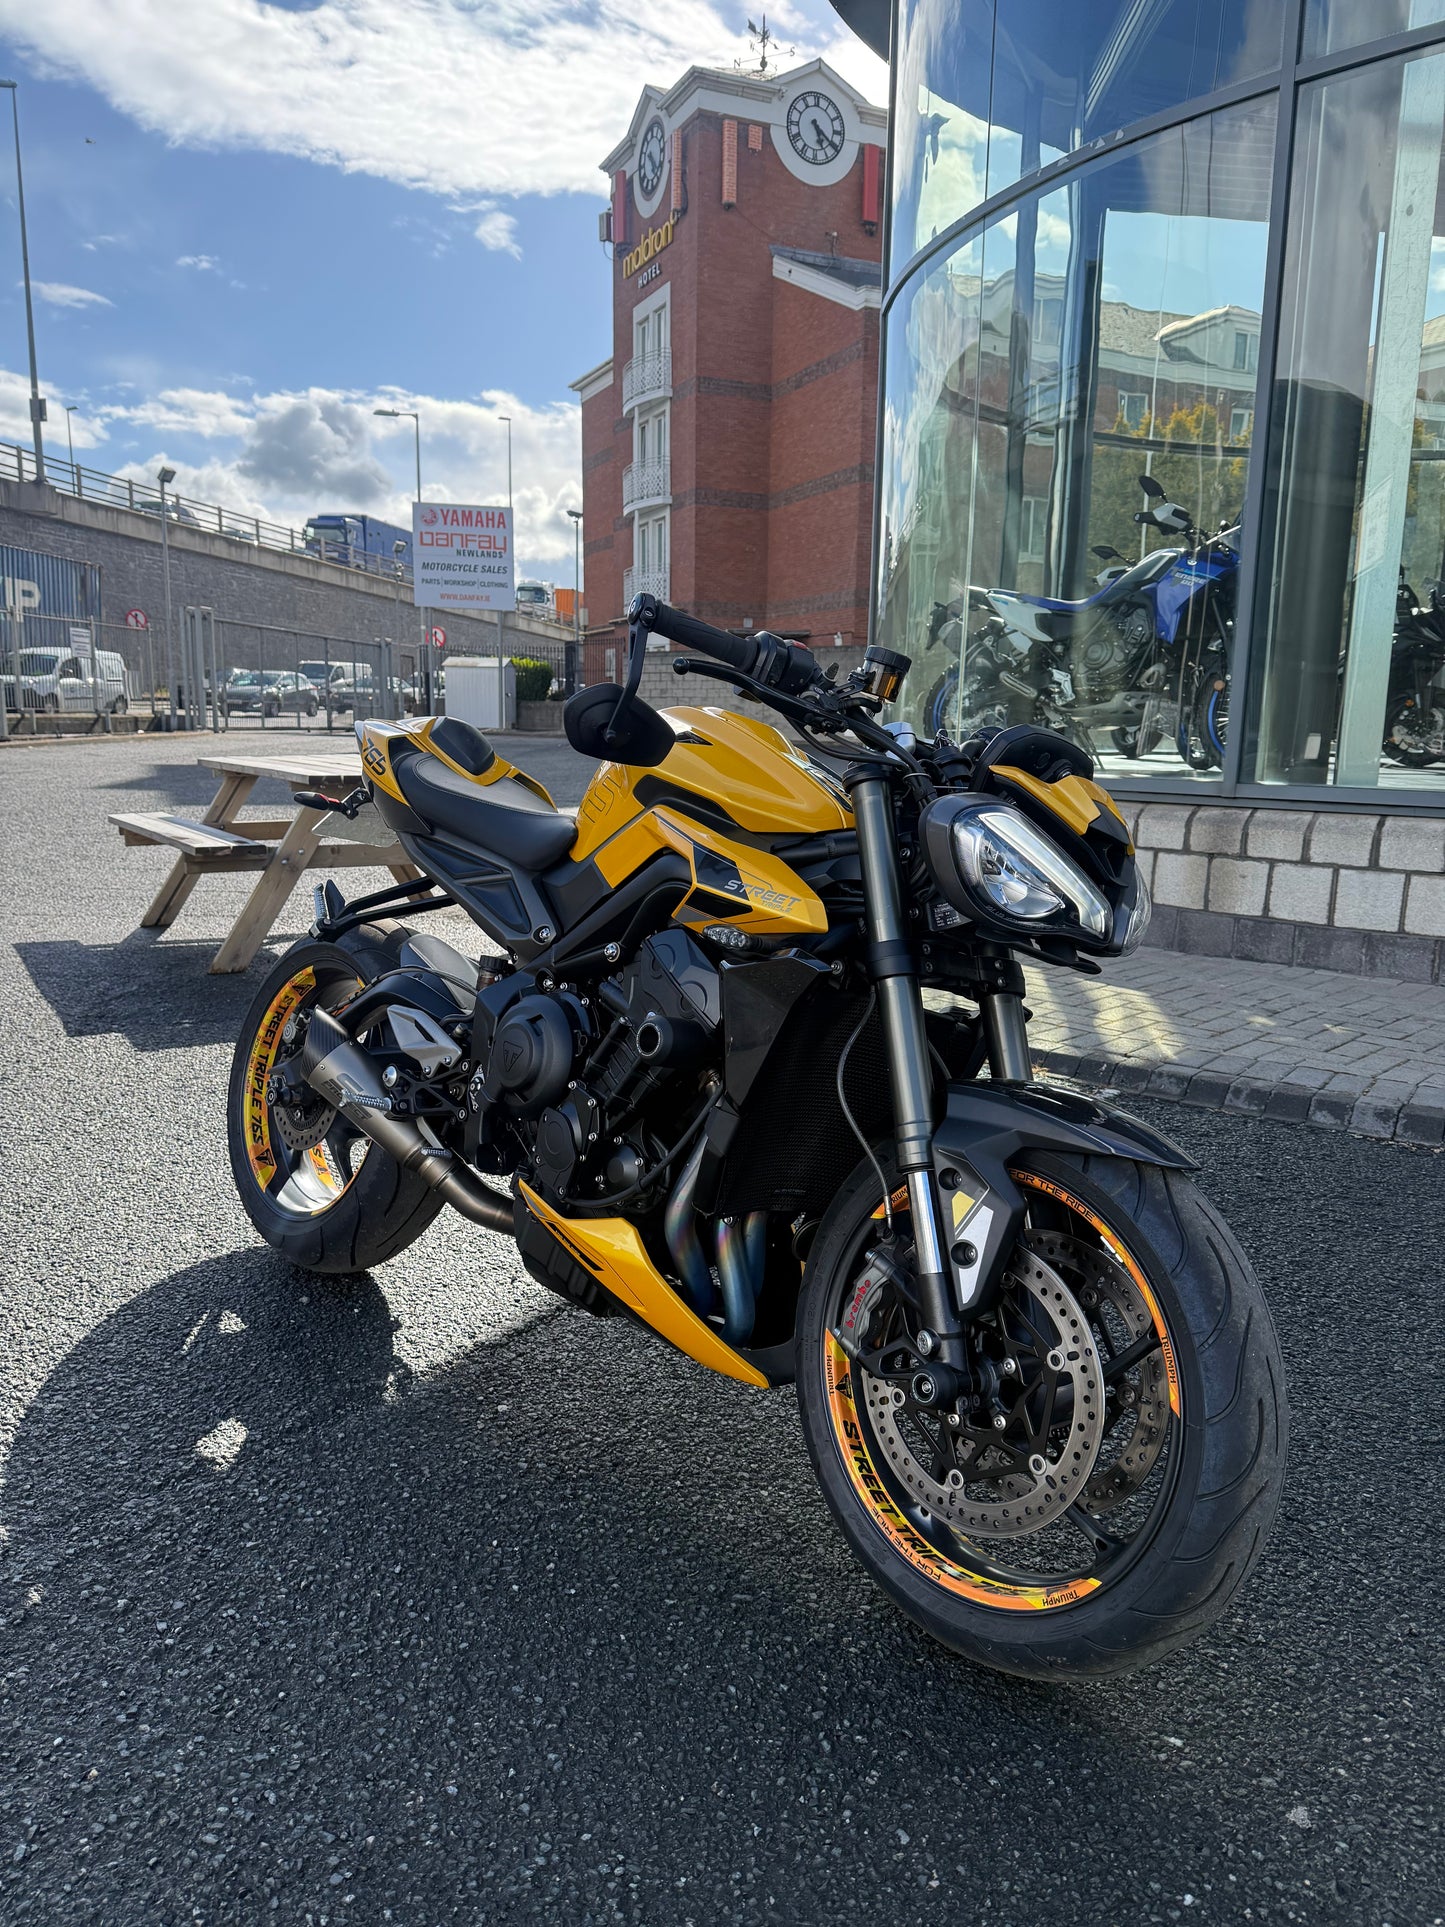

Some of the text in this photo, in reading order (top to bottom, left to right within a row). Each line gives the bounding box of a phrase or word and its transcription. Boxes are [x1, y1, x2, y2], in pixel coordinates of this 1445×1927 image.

[637, 262, 661, 288] HOTEL
[440, 508, 507, 529] YAMAHA
[421, 562, 508, 574] MOTORCYCLE SALES
[456, 549, 504, 559] NEWLANDS
[444, 579, 477, 587] WORKSHOP
[480, 581, 508, 589] CLOTHING
[363, 738, 387, 776] 765
[724, 879, 802, 907] STREET
[762, 900, 792, 913] TRIPLE
[265, 995, 295, 1050] STREET
[251, 1054, 270, 1111] TRIPLE
[252, 1115, 265, 1146] 765
[1009, 1170, 1095, 1222] FOR THE RIDE
[845, 1279, 872, 1329] brembo
[826, 1354, 835, 1396] TRIUMPH
[1162, 1335, 1177, 1384] TRIUMPH
[843, 1420, 901, 1519] STREET
[872, 1506, 942, 1581] FOR THE RIDE
[1042, 1589, 1080, 1608] TRIUMPH
